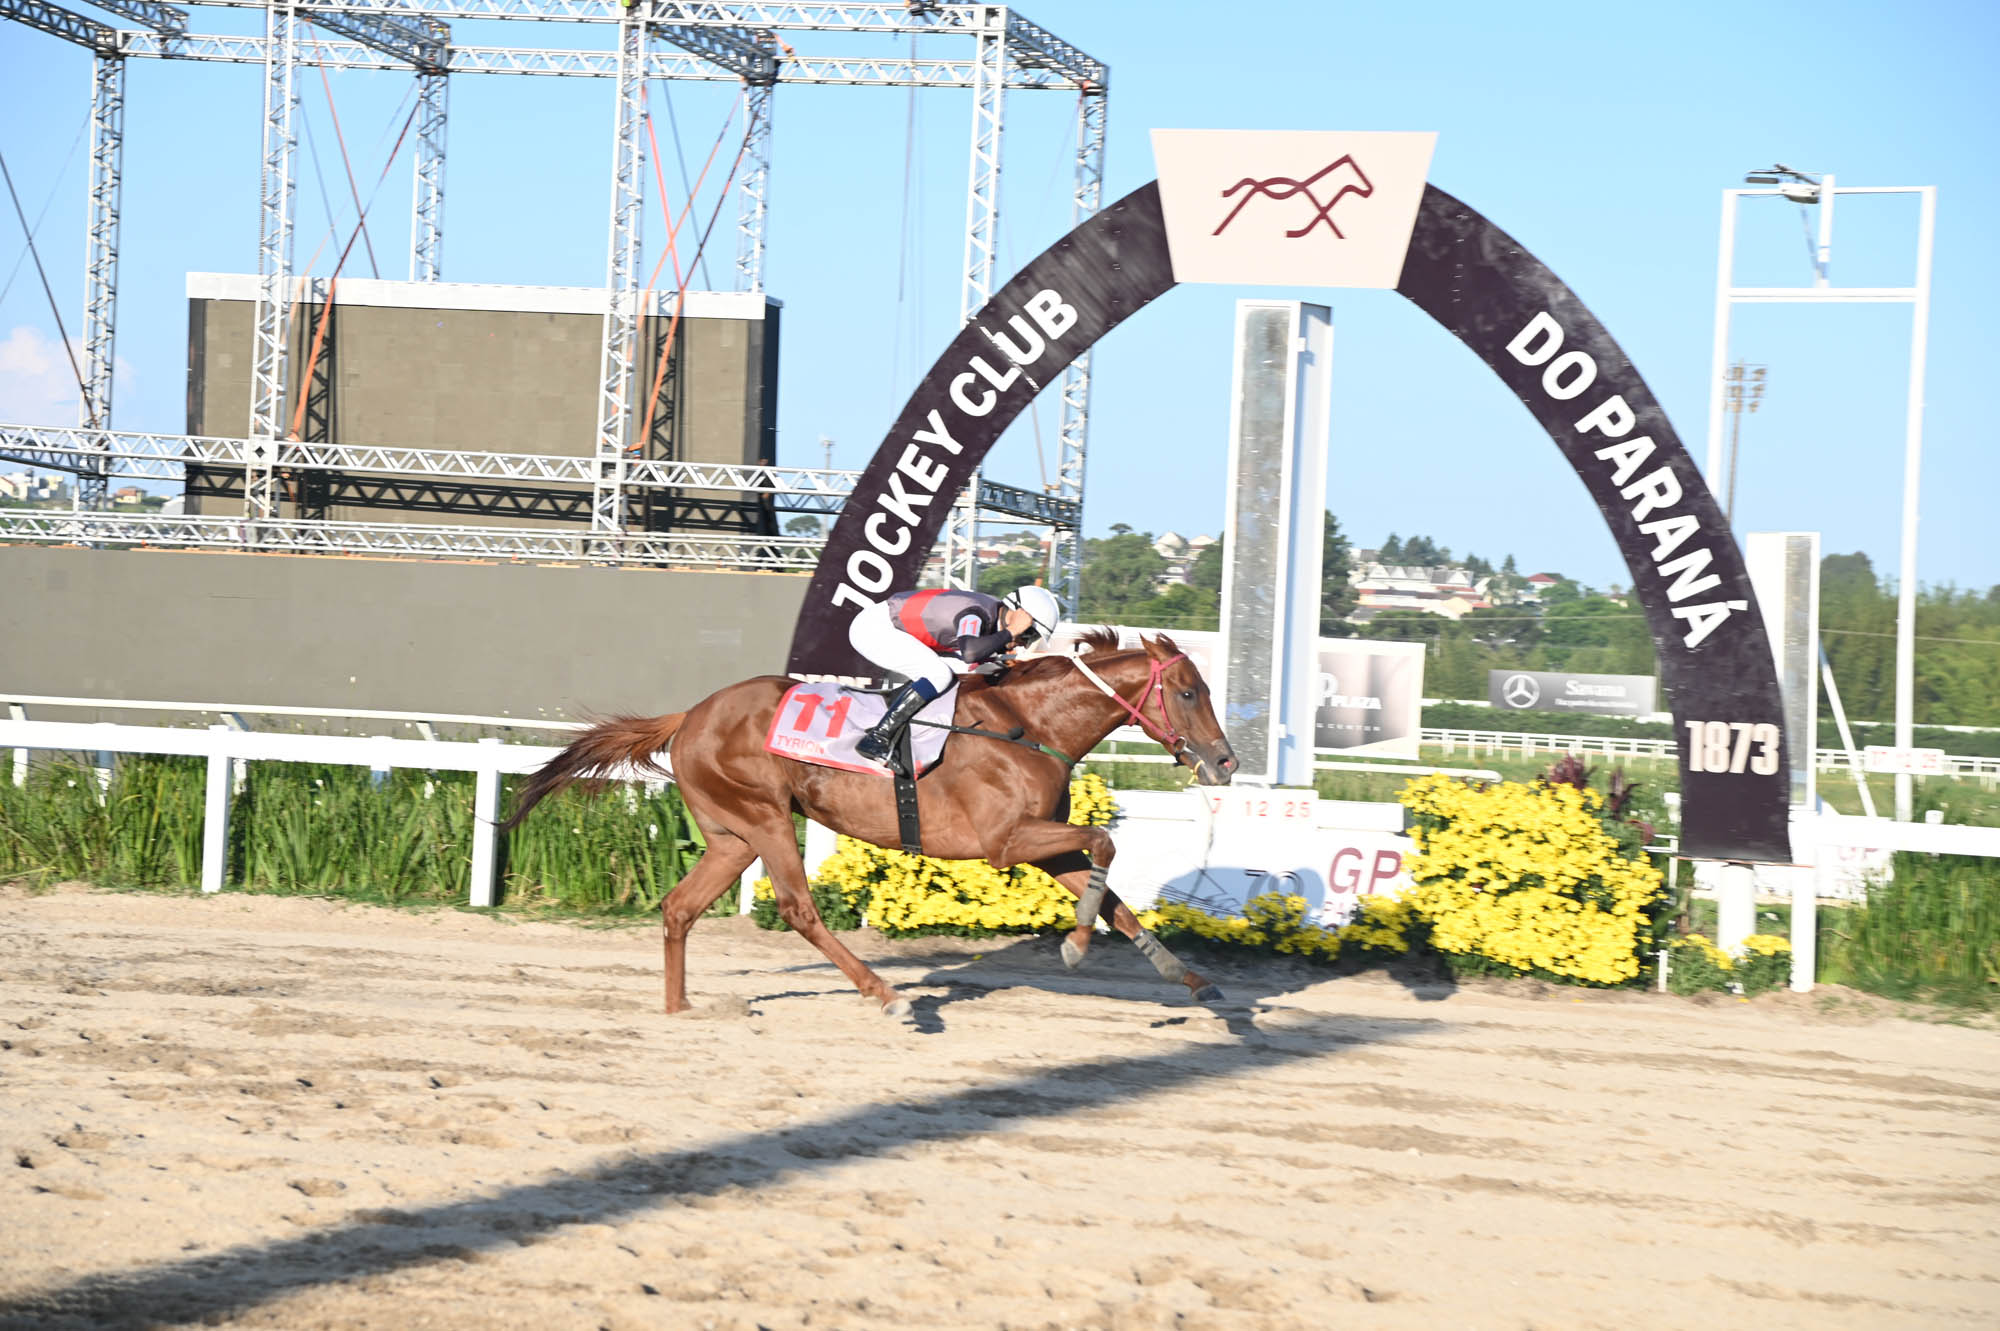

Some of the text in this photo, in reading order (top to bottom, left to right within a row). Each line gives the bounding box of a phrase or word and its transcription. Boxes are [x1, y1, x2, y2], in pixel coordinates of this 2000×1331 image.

[831, 288, 1079, 609] JOCKEY CLUB
[1505, 311, 1598, 401] DO
[1574, 394, 1749, 649] PARANÁ
[960, 619, 979, 636] 11
[792, 693, 853, 739] 11
[1684, 720, 1780, 776] 1873
[1245, 800, 1271, 818] 12
[1283, 800, 1312, 819] 25
[1329, 847, 1402, 895] GP
